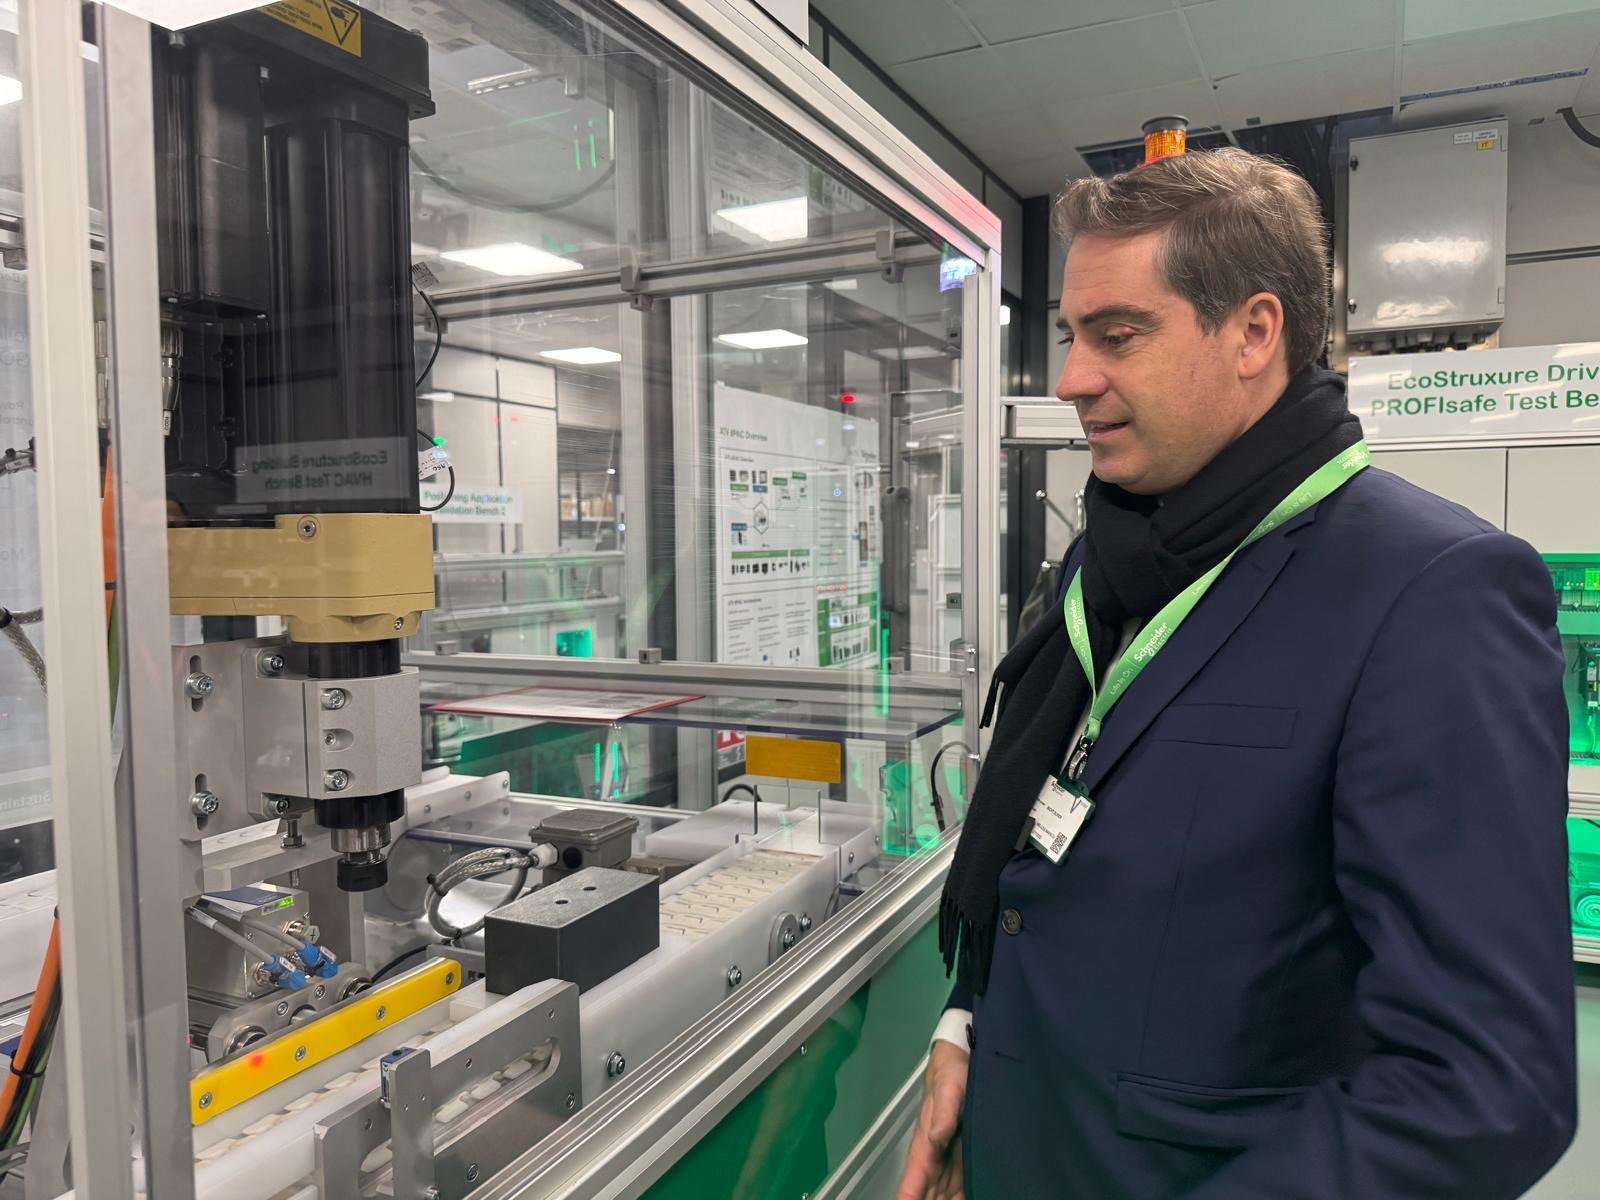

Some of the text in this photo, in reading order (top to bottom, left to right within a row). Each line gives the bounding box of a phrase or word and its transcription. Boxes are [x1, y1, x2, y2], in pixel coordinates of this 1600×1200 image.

[1388, 363, 1600, 390] EcoStruxure Driv
[1371, 389, 1600, 416] PROFIsafe Test Be
[1133, 622, 1167, 662] Schneider
